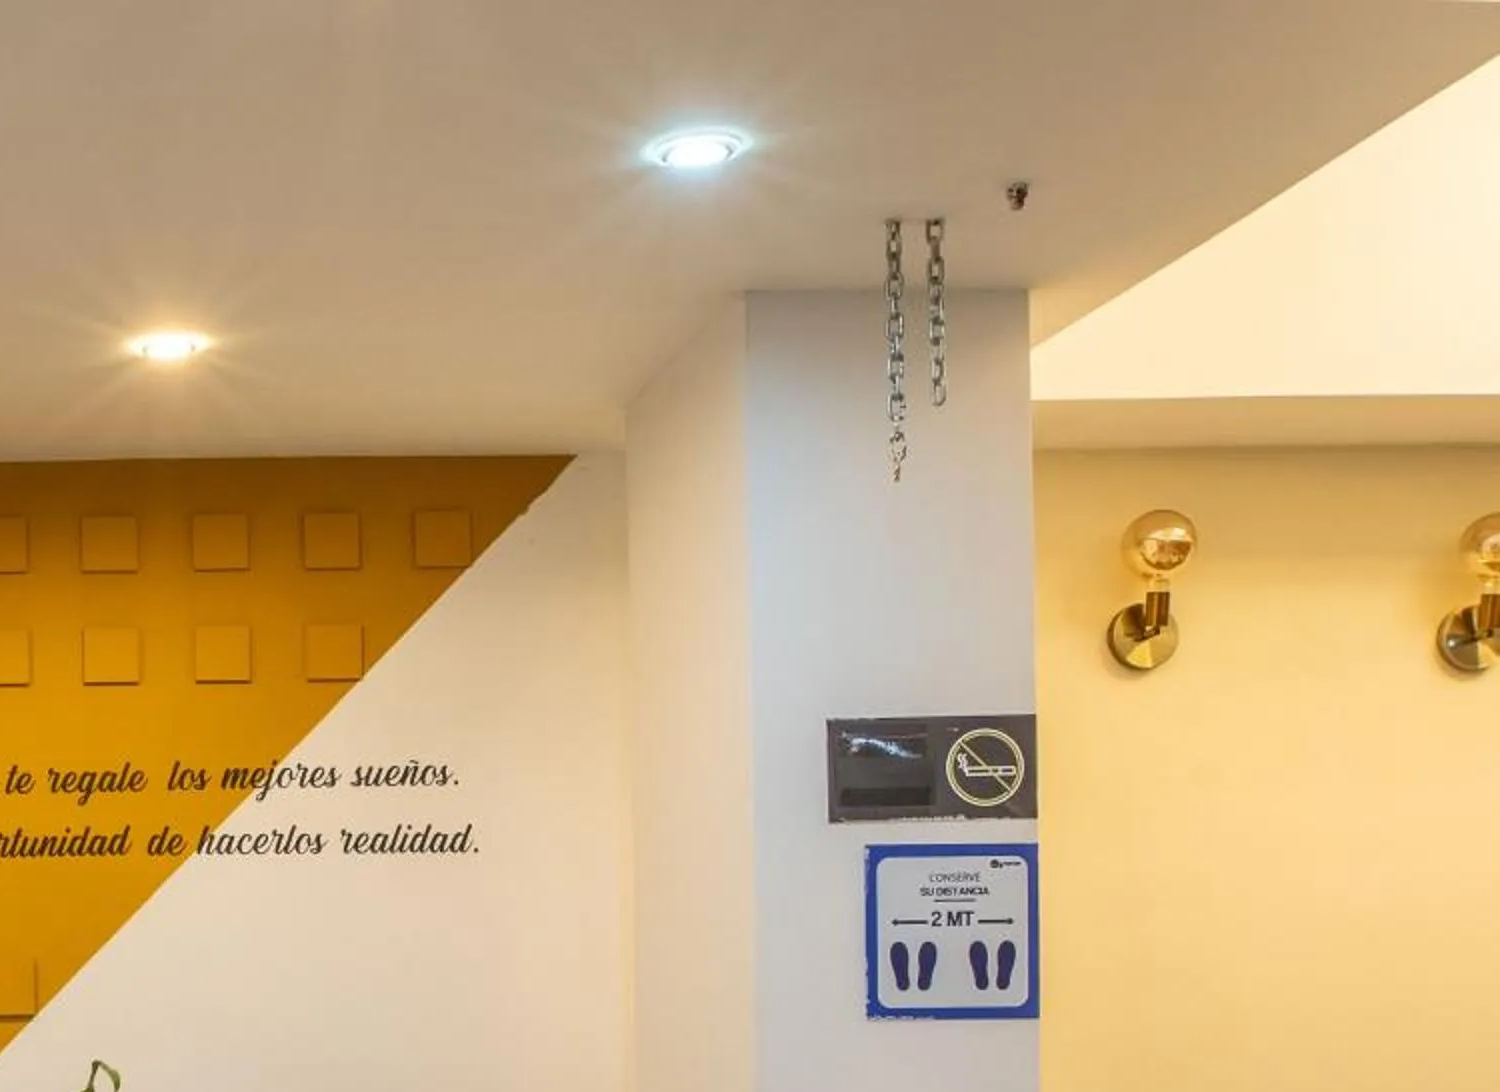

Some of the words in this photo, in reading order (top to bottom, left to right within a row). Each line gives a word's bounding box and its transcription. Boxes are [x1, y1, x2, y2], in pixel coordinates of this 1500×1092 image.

[5, 764, 36, 795] te
[47, 761, 149, 806] regale
[167, 760, 212, 791] los
[220, 760, 342, 802] mejores
[350, 759, 461, 788] sueños.
[147, 825, 188, 857] de
[197, 825, 329, 856] hacerlos
[340, 823, 480, 855] realidad.
[929, 871, 981, 883] CONSERVE
[920, 886, 935, 897] SU
[936, 886, 990, 897] DISTANCIA
[931, 911, 943, 927] 2
[946, 911, 975, 927] MT
